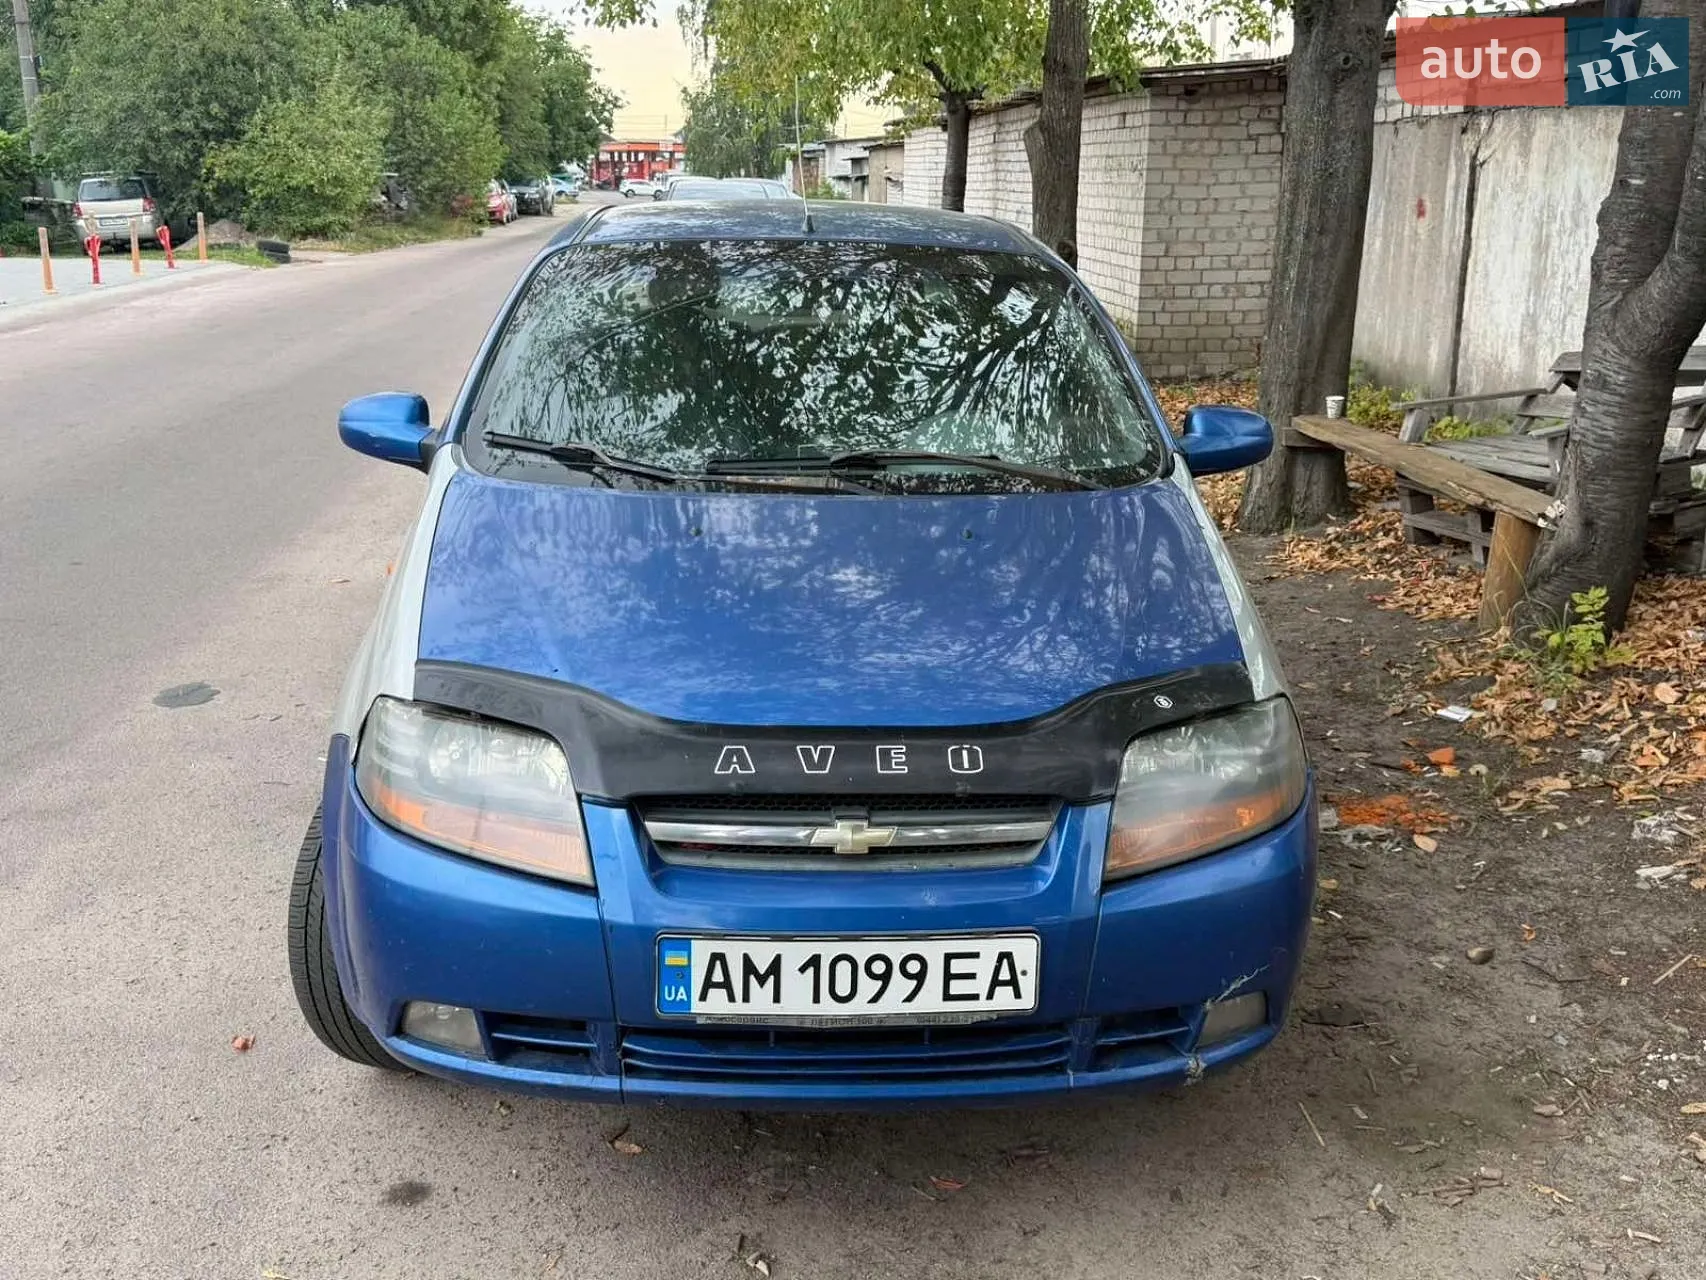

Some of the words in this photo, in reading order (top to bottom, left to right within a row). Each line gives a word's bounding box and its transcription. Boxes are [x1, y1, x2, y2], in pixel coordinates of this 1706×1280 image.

[714, 744, 984, 774] AVEO
[698, 952, 782, 1004] AM
[797, 952, 929, 1004] 1099
[942, 951, 1023, 1002] EA
[664, 985, 688, 1002] UA
